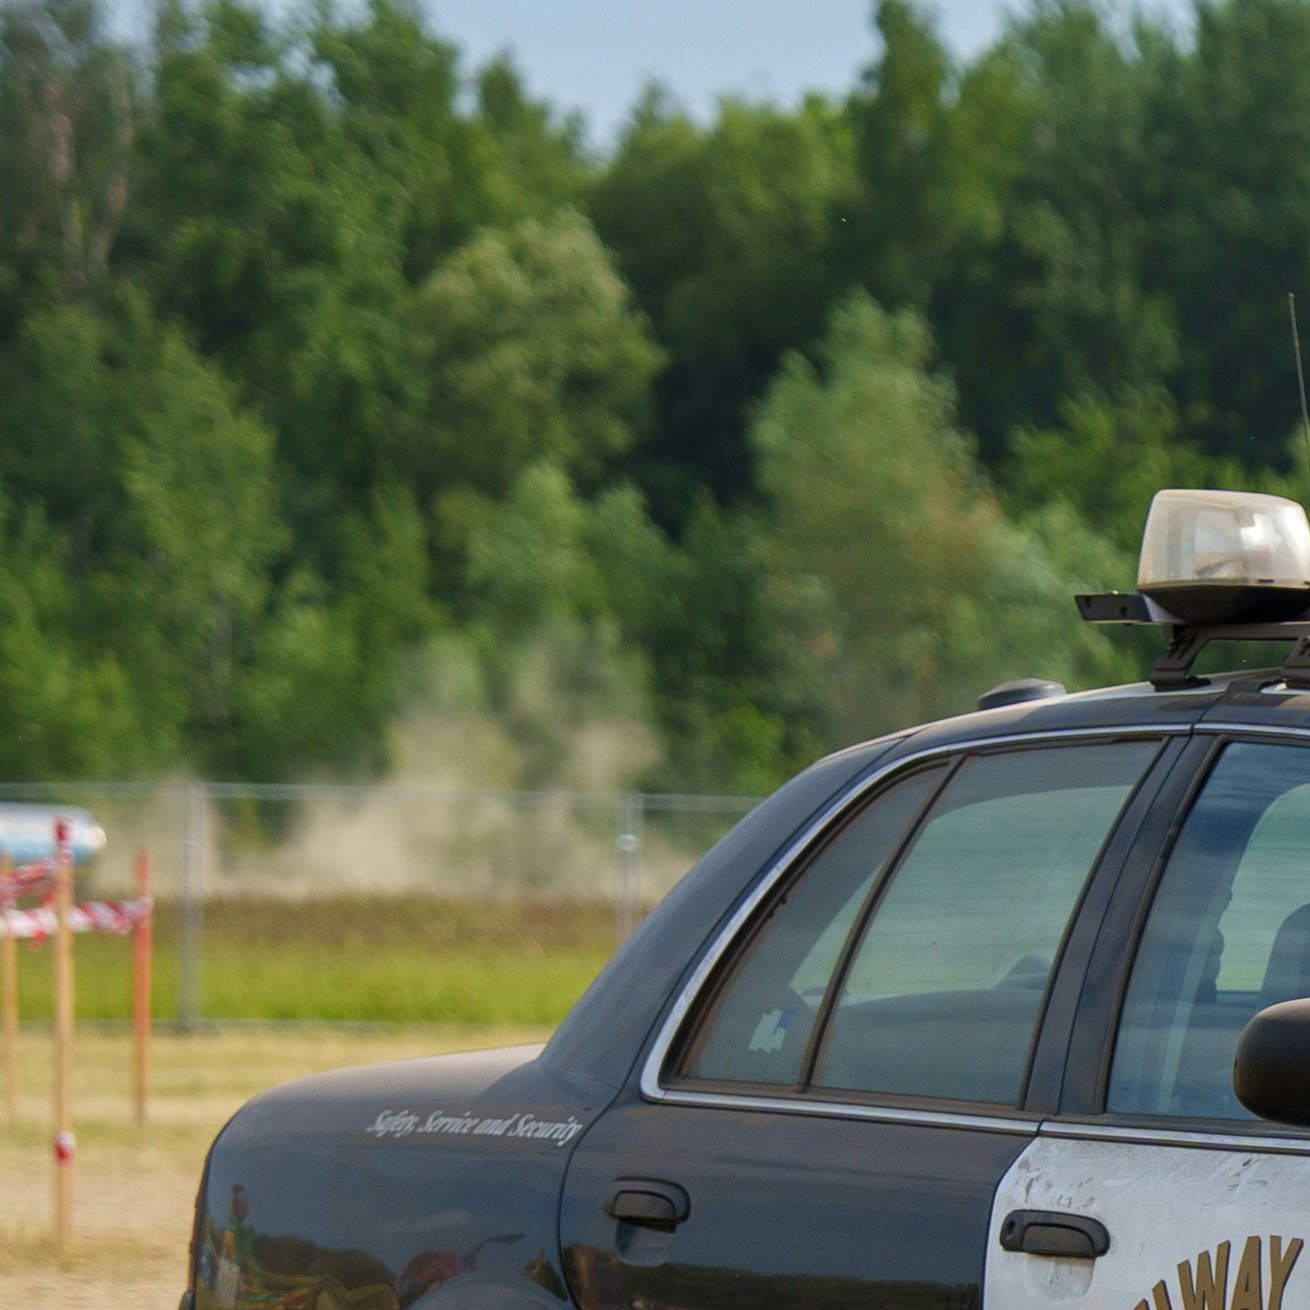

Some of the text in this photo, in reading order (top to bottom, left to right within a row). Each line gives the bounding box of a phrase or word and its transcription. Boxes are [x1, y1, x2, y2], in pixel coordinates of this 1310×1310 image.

[417, 1110, 480, 1134] Service
[473, 1113, 521, 1136] and
[507, 1113, 583, 1147] Security
